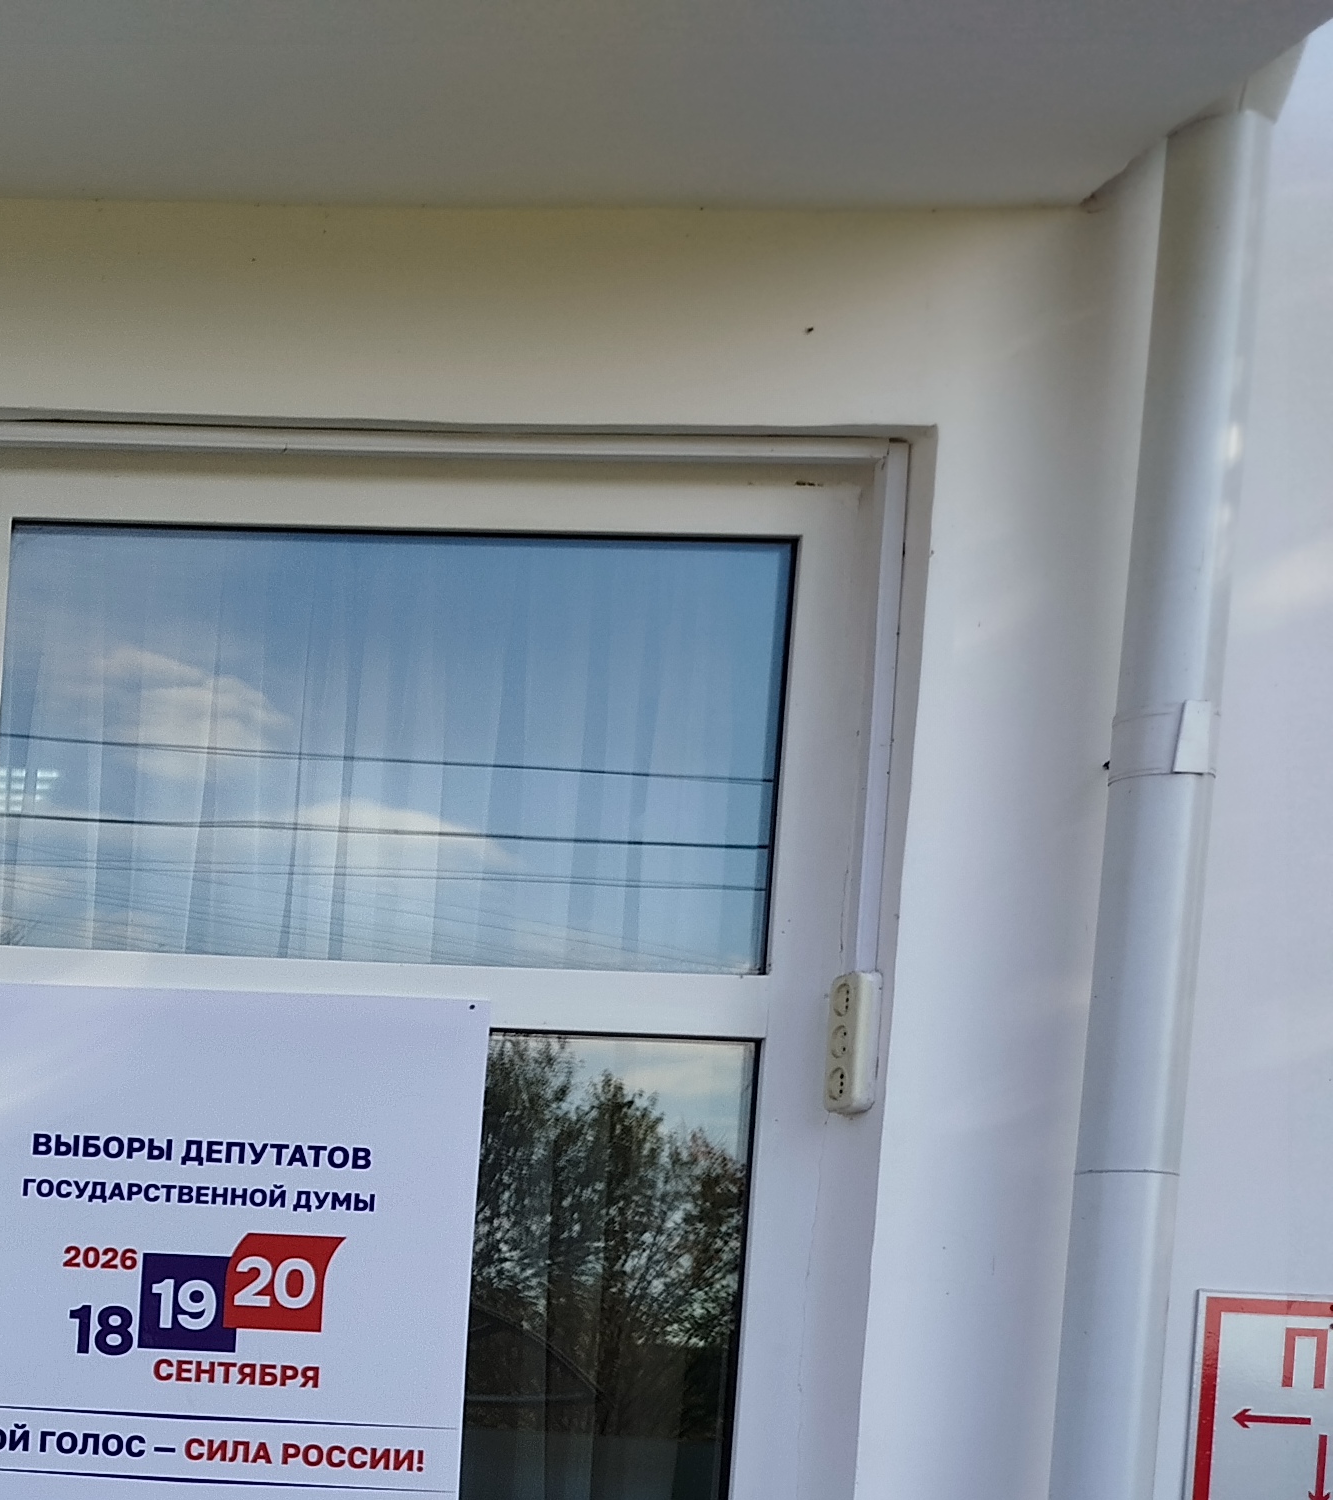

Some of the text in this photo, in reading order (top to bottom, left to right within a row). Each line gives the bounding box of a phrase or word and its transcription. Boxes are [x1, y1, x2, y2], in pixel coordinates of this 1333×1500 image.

[32, 1133, 372, 1170] ВЫБОРЫ ДЕПУТАТОВ
[22, 1178, 376, 1213] ГОСУДАРСТВЕННОЙ ДУМЫ
[64, 1246, 137, 1271] 2026
[69, 1255, 316, 1356] 18 19 20
[154, 1359, 320, 1388] СЕНТЯБРЯ
[39, 1430, 146, 1458] ГОЛОС
[185, 1439, 272, 1464] СИЛА
[282, 1443, 424, 1471] РОССИИ!
